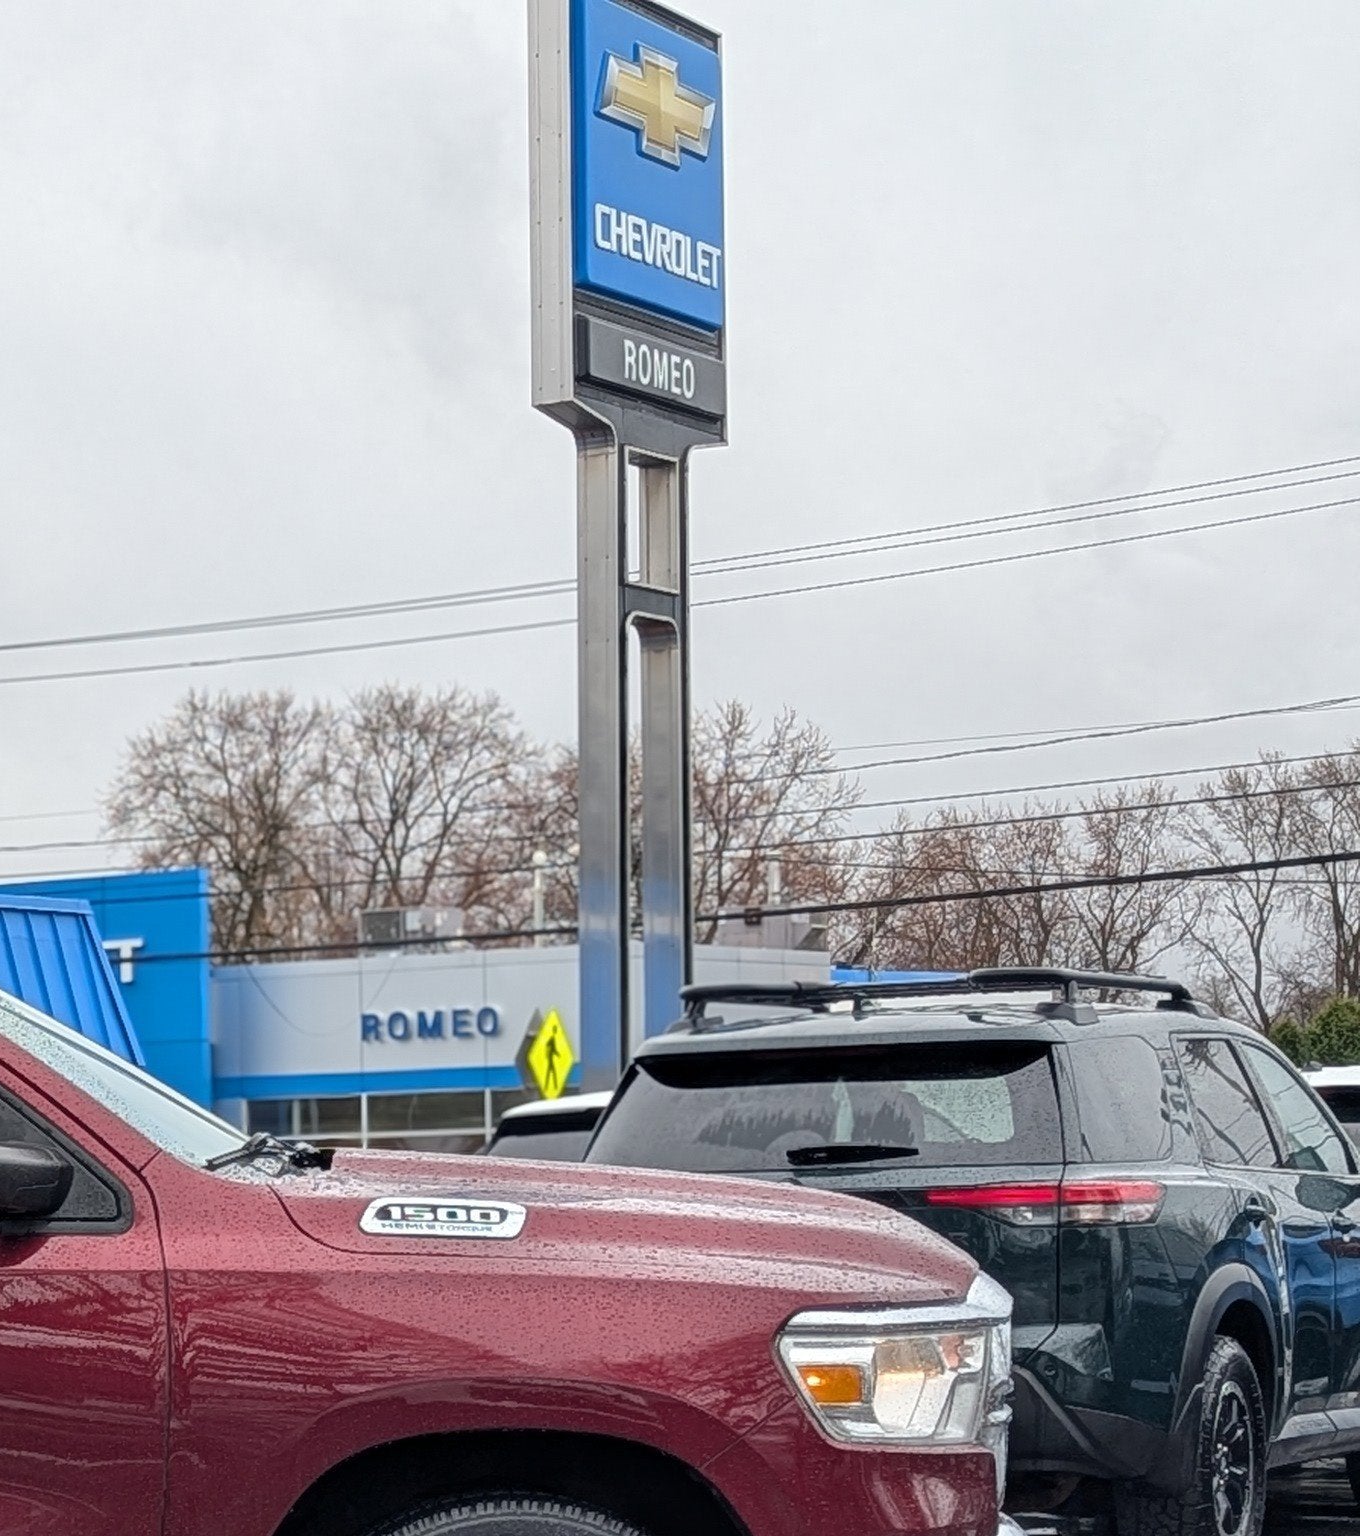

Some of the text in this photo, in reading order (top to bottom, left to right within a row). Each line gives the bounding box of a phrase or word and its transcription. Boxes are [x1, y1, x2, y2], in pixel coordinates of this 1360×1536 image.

[595, 202, 721, 288] CHEVROLET
[623, 339, 695, 399] ROMEO
[362, 1006, 500, 1042] ROMEO
[387, 1205, 501, 1223] 1500
